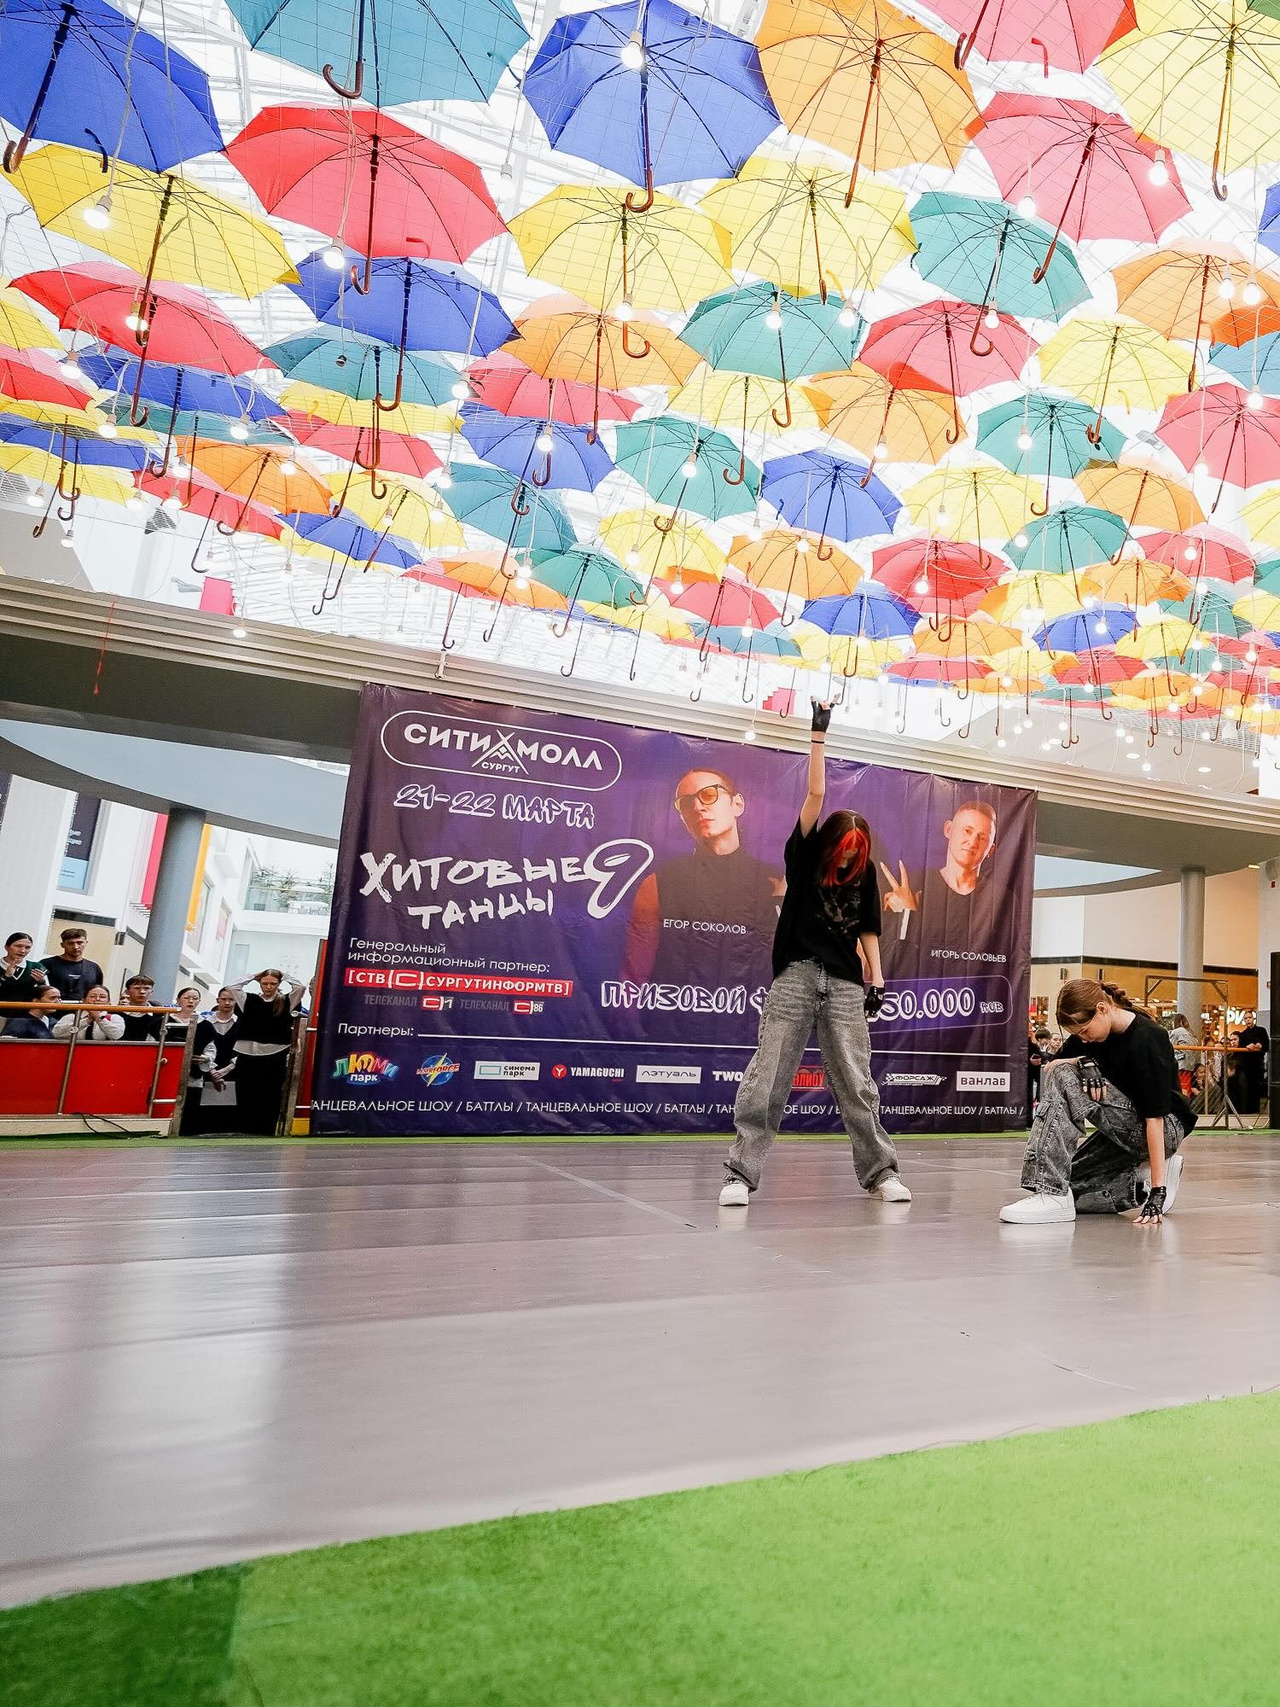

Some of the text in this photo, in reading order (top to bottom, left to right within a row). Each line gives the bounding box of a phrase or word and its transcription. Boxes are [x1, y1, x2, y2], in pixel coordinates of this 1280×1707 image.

[404, 723, 603, 771] СИТИ МОЛЛ
[481, 762, 521, 774] СУРГУТ
[394, 784, 595, 829] 21-22 МАРТА
[360, 851, 589, 903] ХИТОВЫЕ
[407, 887, 554, 930] ТАНЦЫ
[663, 918, 747, 935] ЕГОР СОКОЛОВ
[350, 937, 446, 954] Генеральный
[348, 951, 550, 974] информационный партнер:
[931, 949, 1007, 964] ИГОРЬ СОЛОВЬЕВ
[364, 994, 417, 1006] ТЕЛЕКАНАЛ
[460, 999, 509, 1011] ТЕЛЕКАНАЛ
[601, 981, 746, 1015] ПРИЗОВОЙ
[867, 987, 1004, 1022] 50.000 RUB
[338, 1023, 414, 1037] Партнеры:
[350, 1073, 378, 1083] парк
[570, 1067, 625, 1078] YAMAGUCHI
[419, 1101, 452, 1112] ШОУ
[466, 1102, 513, 1112] БАТТЛЫ
[526, 1102, 621, 1113] ТАНЦЕВАЛЬНОЕ
[624, 1103, 653, 1113] ШОУ
[664, 1103, 705, 1114] БАТТЛЫ
[801, 1105, 827, 1115] ШОУ
[880, 1105, 952, 1116] ТАНЦЕВАЛЬНОЕ
[954, 1106, 977, 1115] ШОУ
[984, 1106, 1018, 1115] БАТТЛЫ
